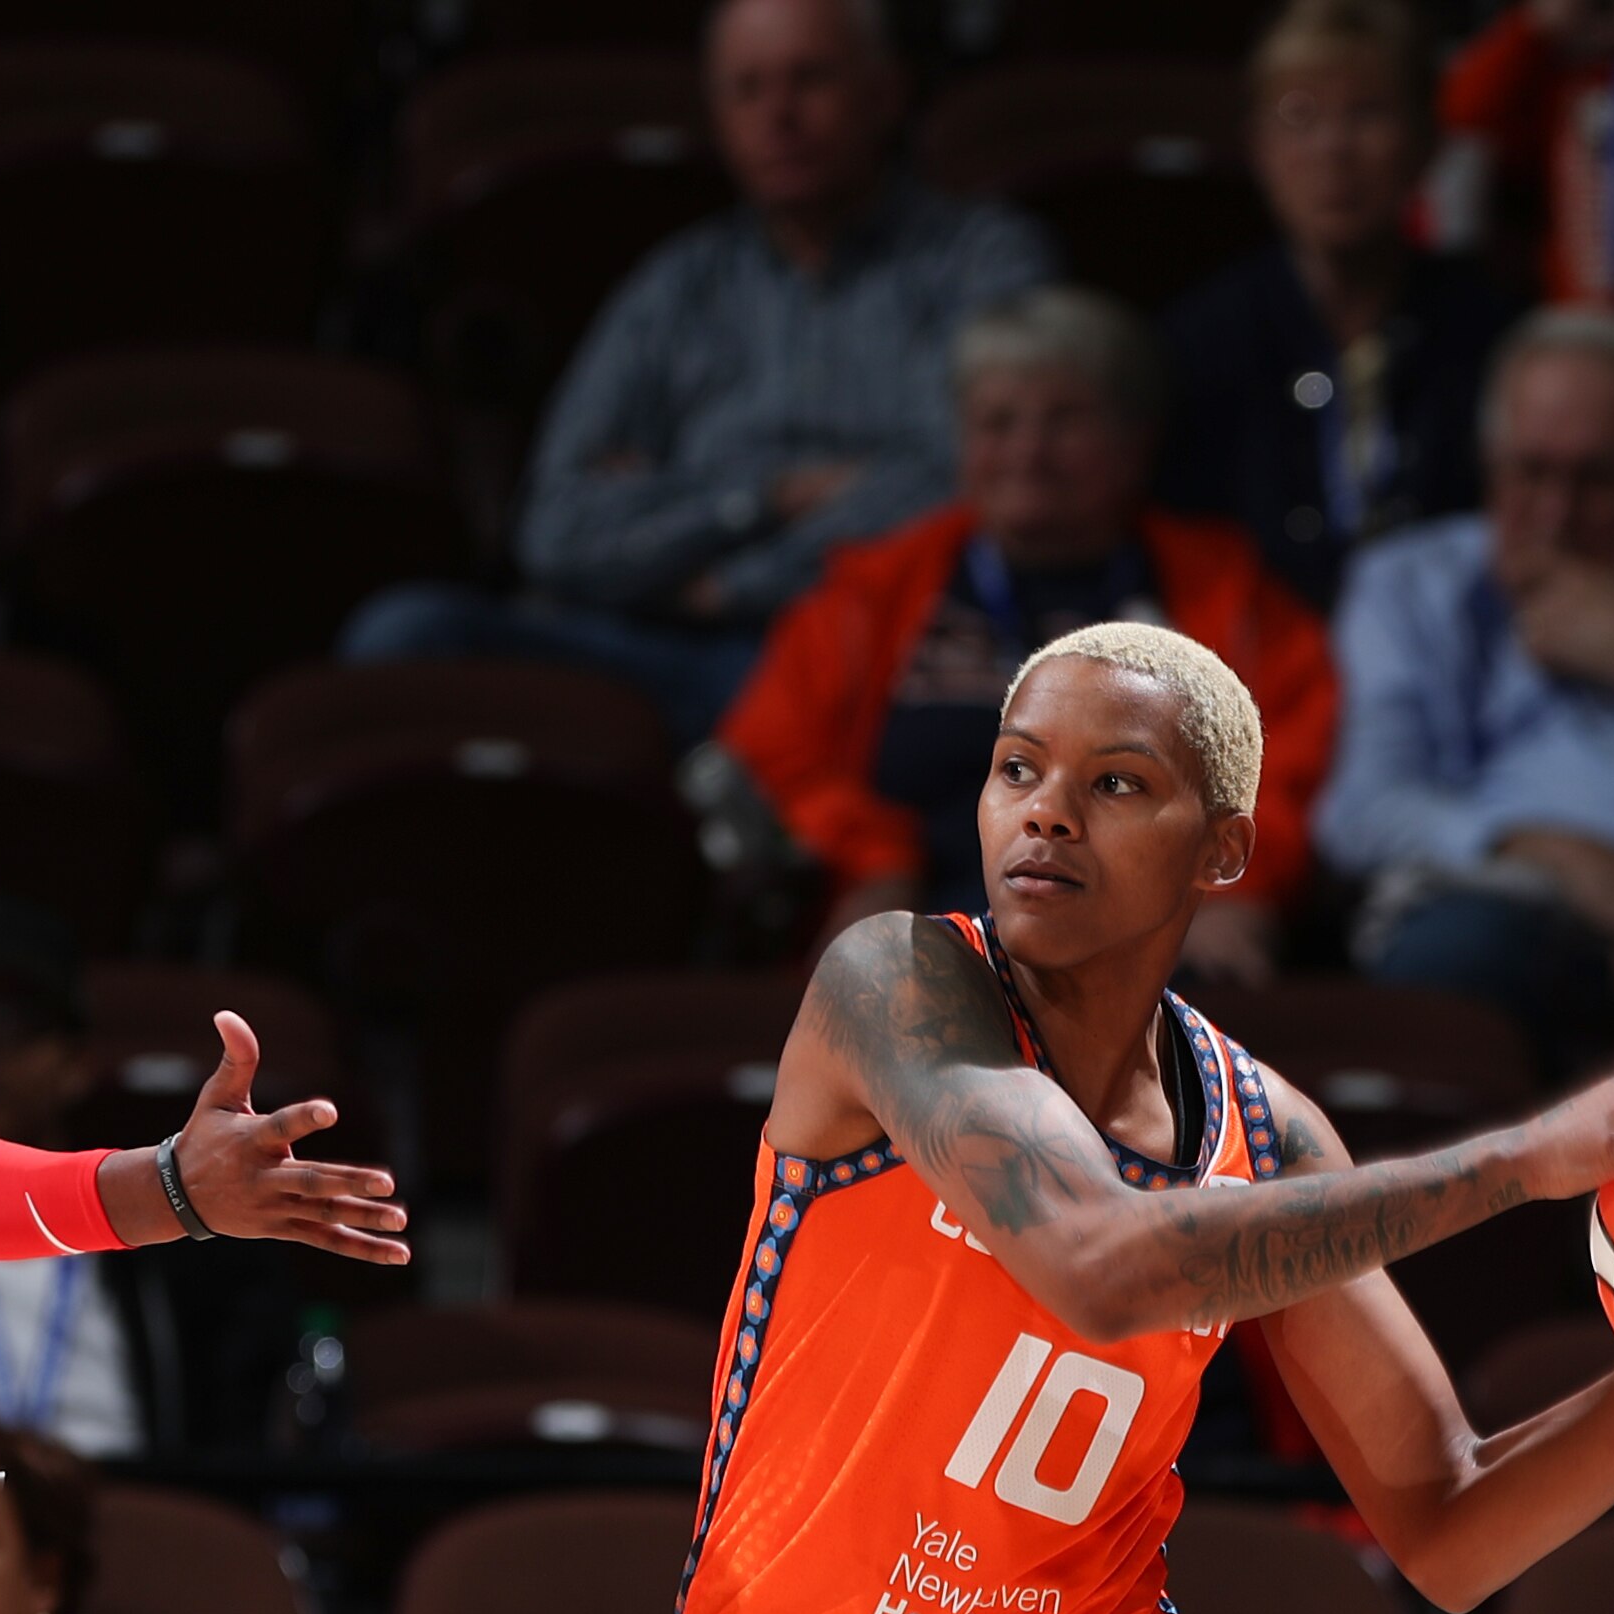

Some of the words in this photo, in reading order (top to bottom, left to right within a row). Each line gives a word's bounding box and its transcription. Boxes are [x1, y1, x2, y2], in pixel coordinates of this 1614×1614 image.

[161, 1167, 185, 1212] Mental
[944, 1332, 1145, 1526] 10
[912, 1511, 978, 1571] Yale
